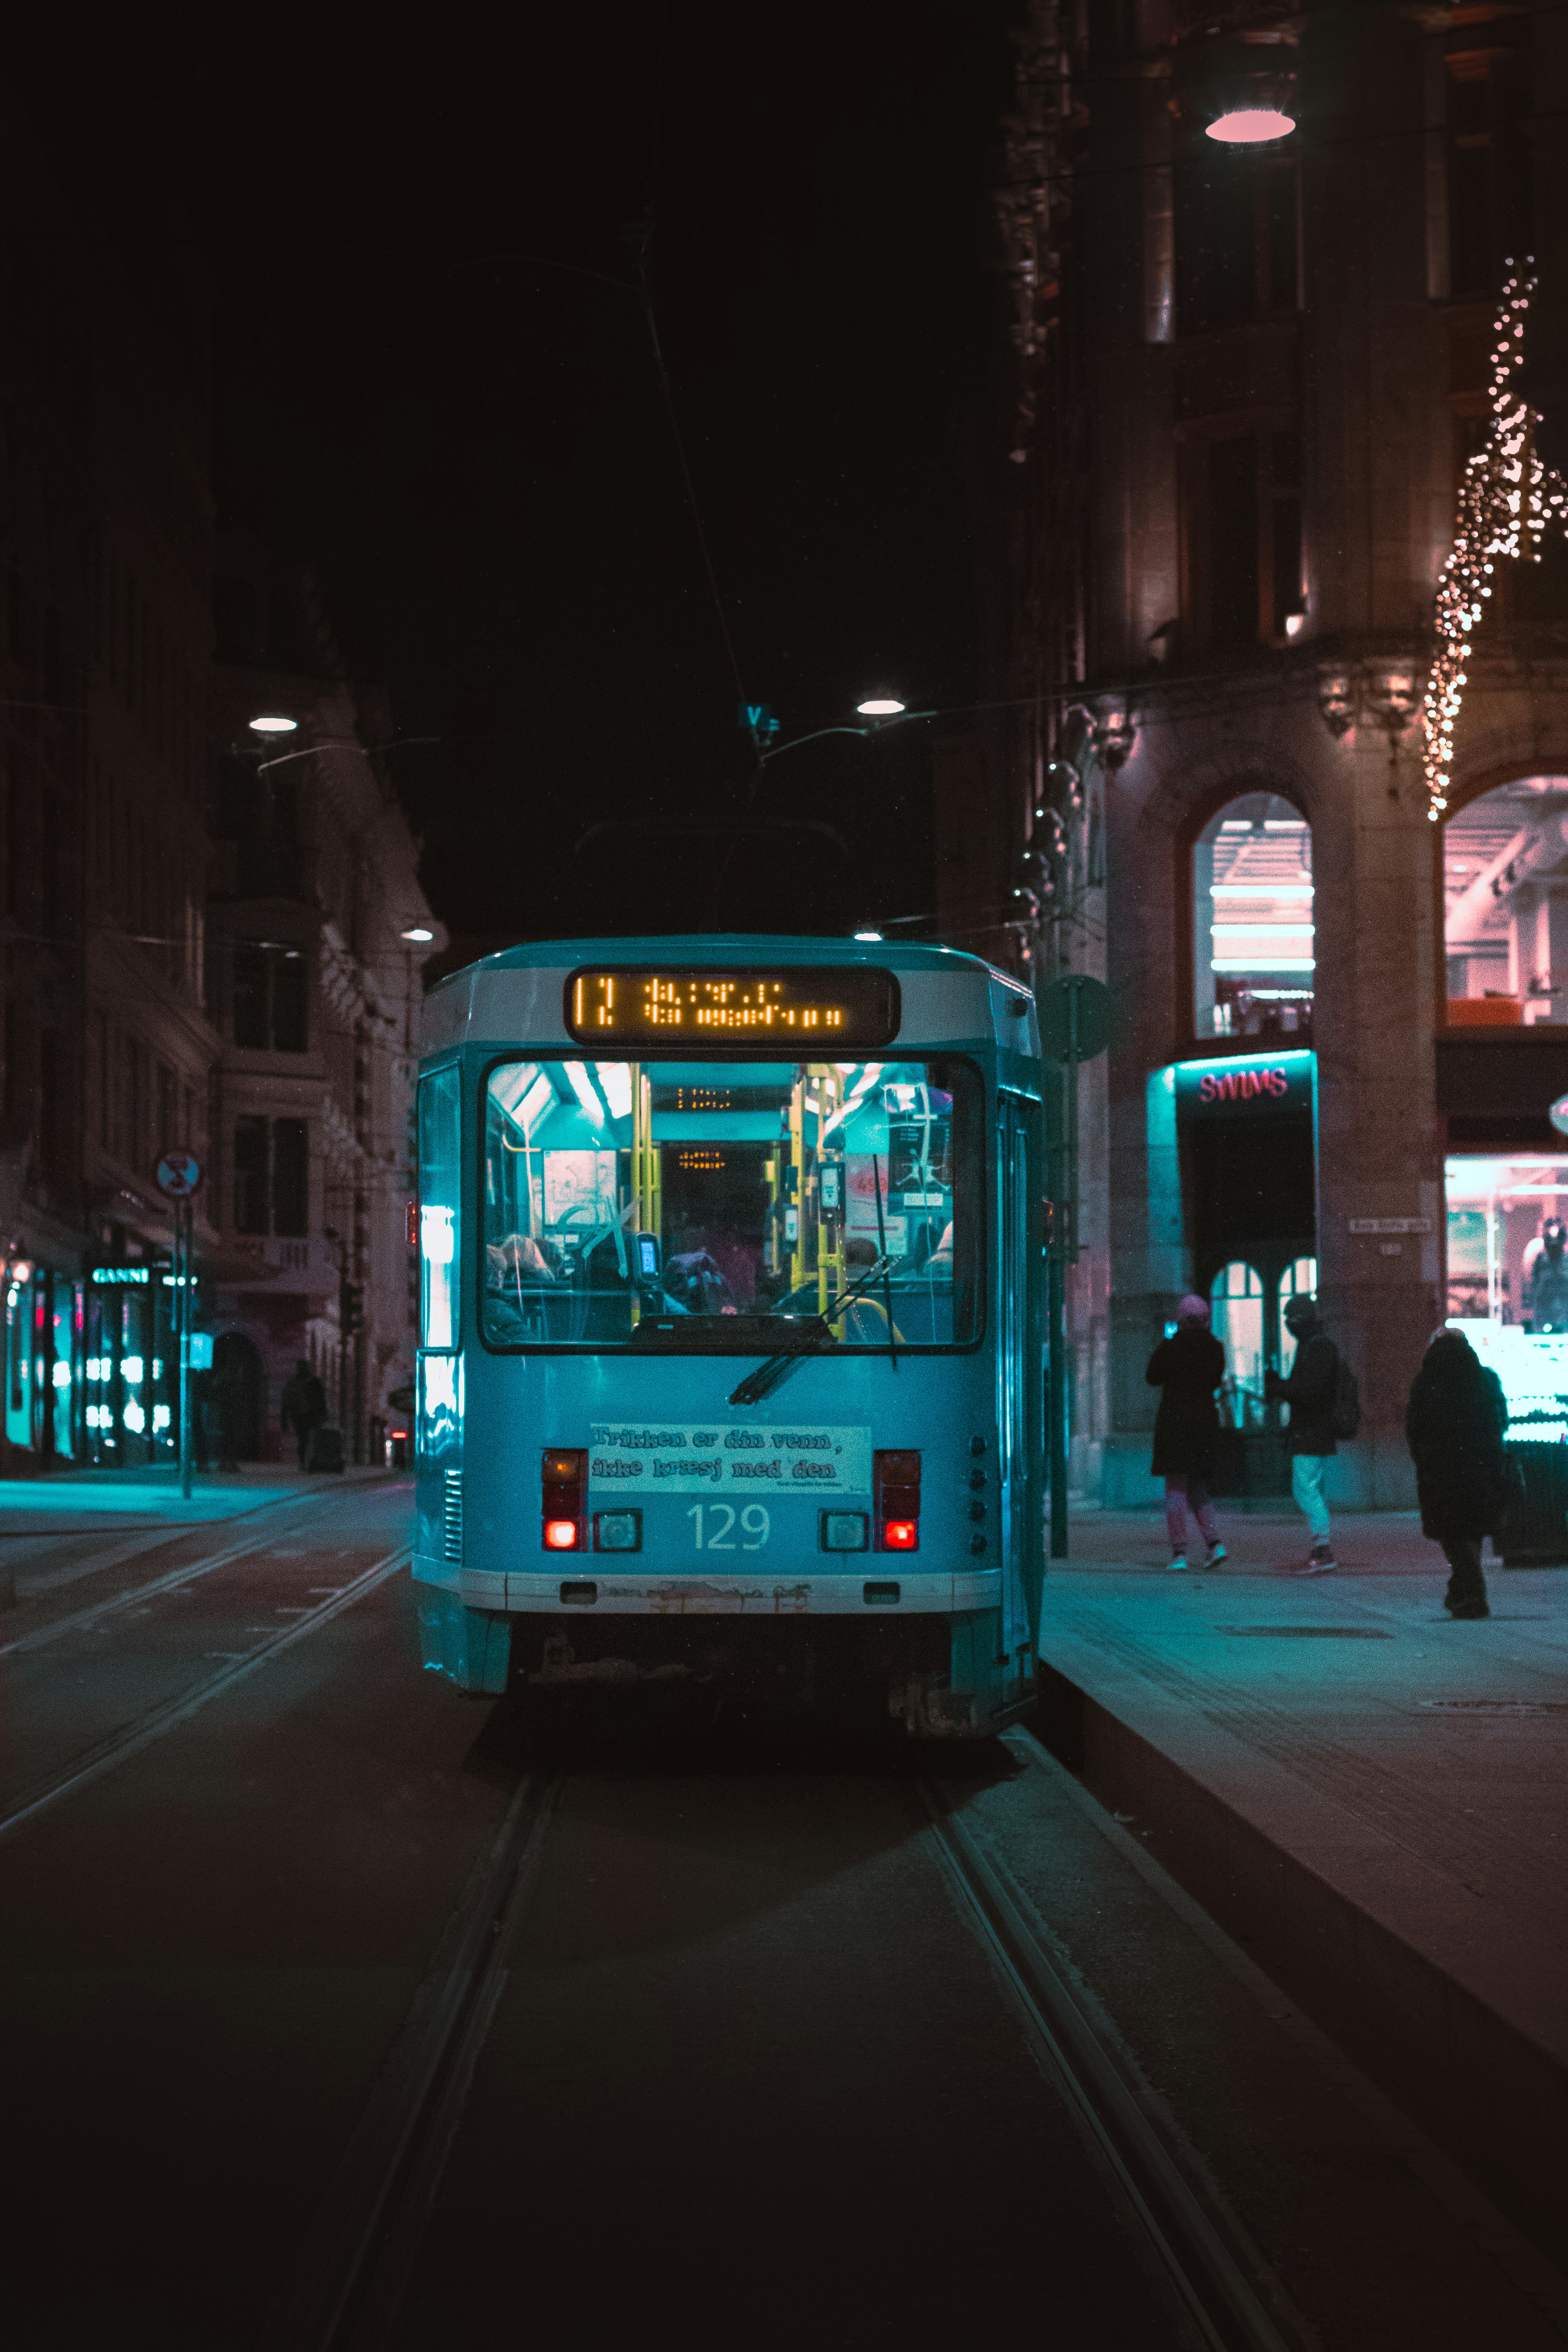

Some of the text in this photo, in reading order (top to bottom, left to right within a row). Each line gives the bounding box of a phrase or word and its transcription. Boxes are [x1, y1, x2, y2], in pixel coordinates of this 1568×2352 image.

[1200, 1067, 1288, 1102] SWIMS
[591, 1427, 842, 1455] Trikken er din venn,
[592, 1458, 837, 1482] ikke kræsj med den
[687, 1504, 769, 1550] 129
